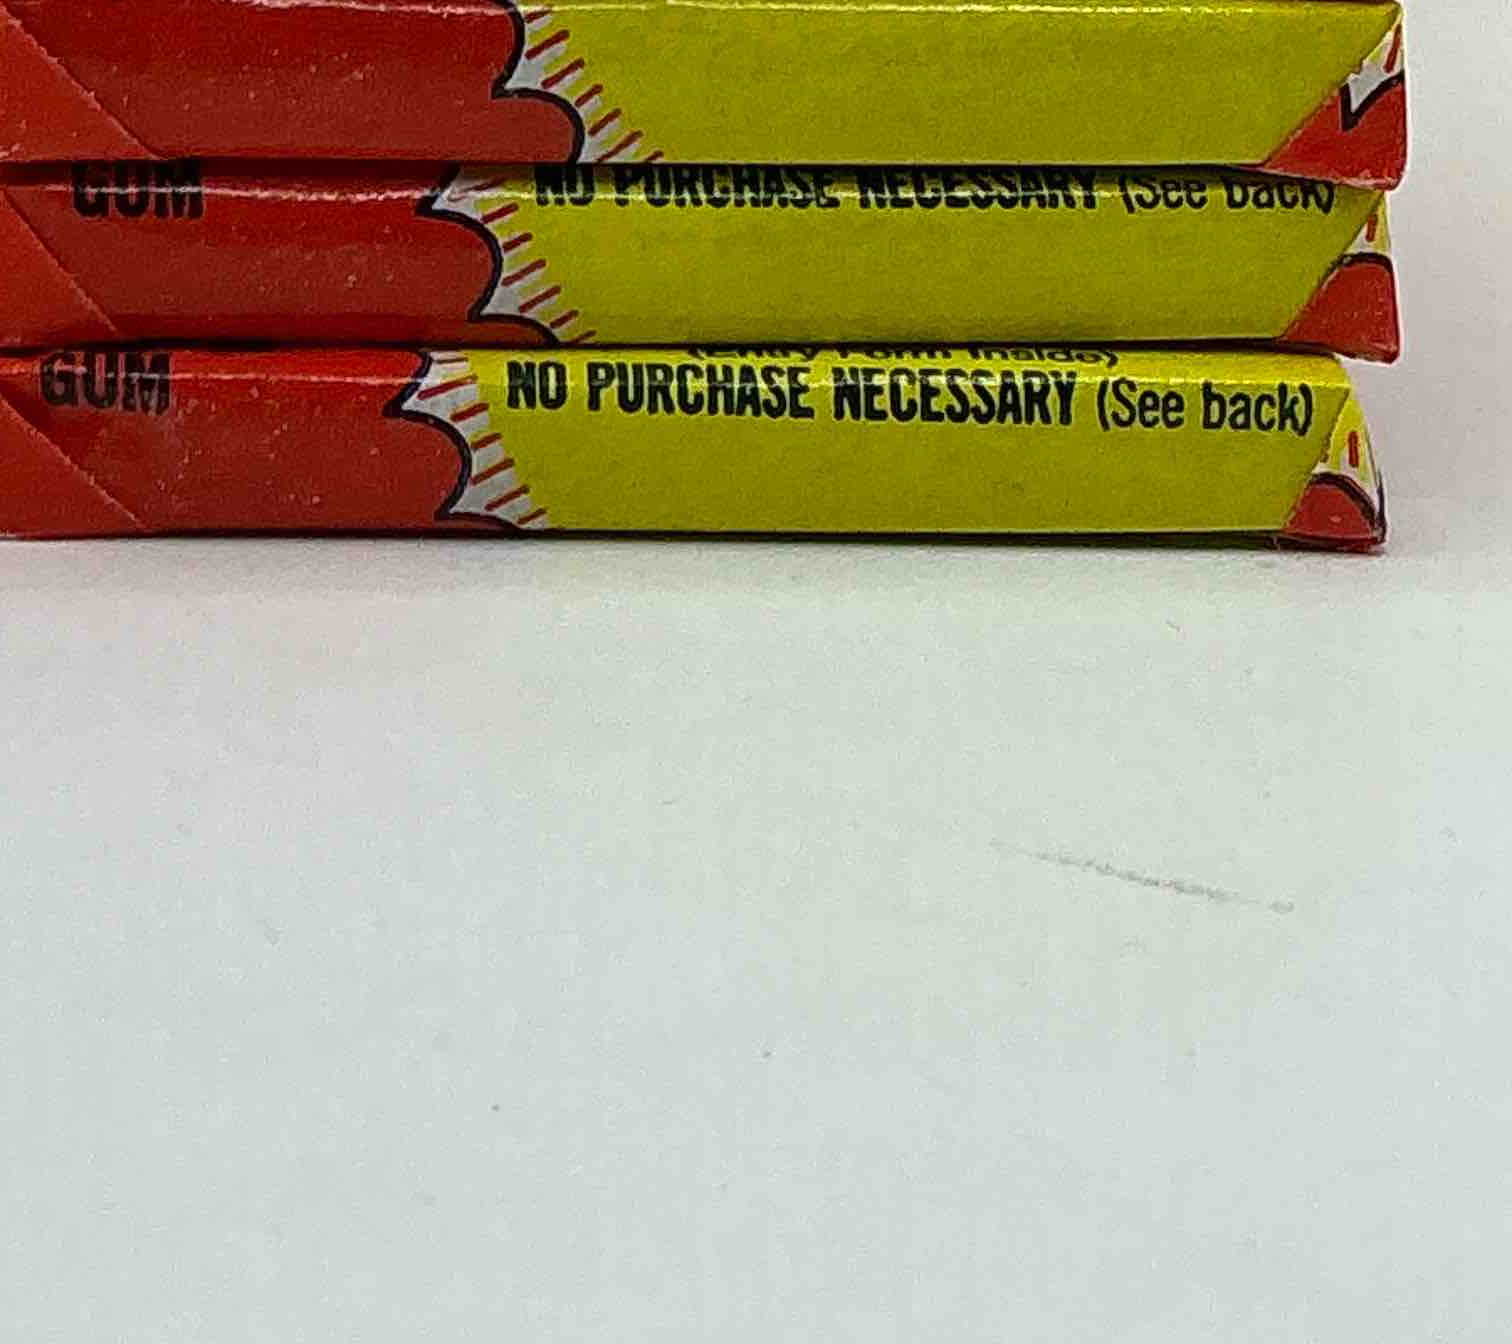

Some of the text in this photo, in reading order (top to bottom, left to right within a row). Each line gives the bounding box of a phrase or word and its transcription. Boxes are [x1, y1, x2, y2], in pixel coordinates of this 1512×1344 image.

[71, 160, 204, 220] GUM
[535, 165, 594, 207] NO
[615, 165, 841, 209] PURCHASE
[857, 165, 1096, 210] NECESSARY
[39, 350, 172, 416] GUM
[506, 361, 1313, 436] NO PURCHASE NECESSARY (See back)
